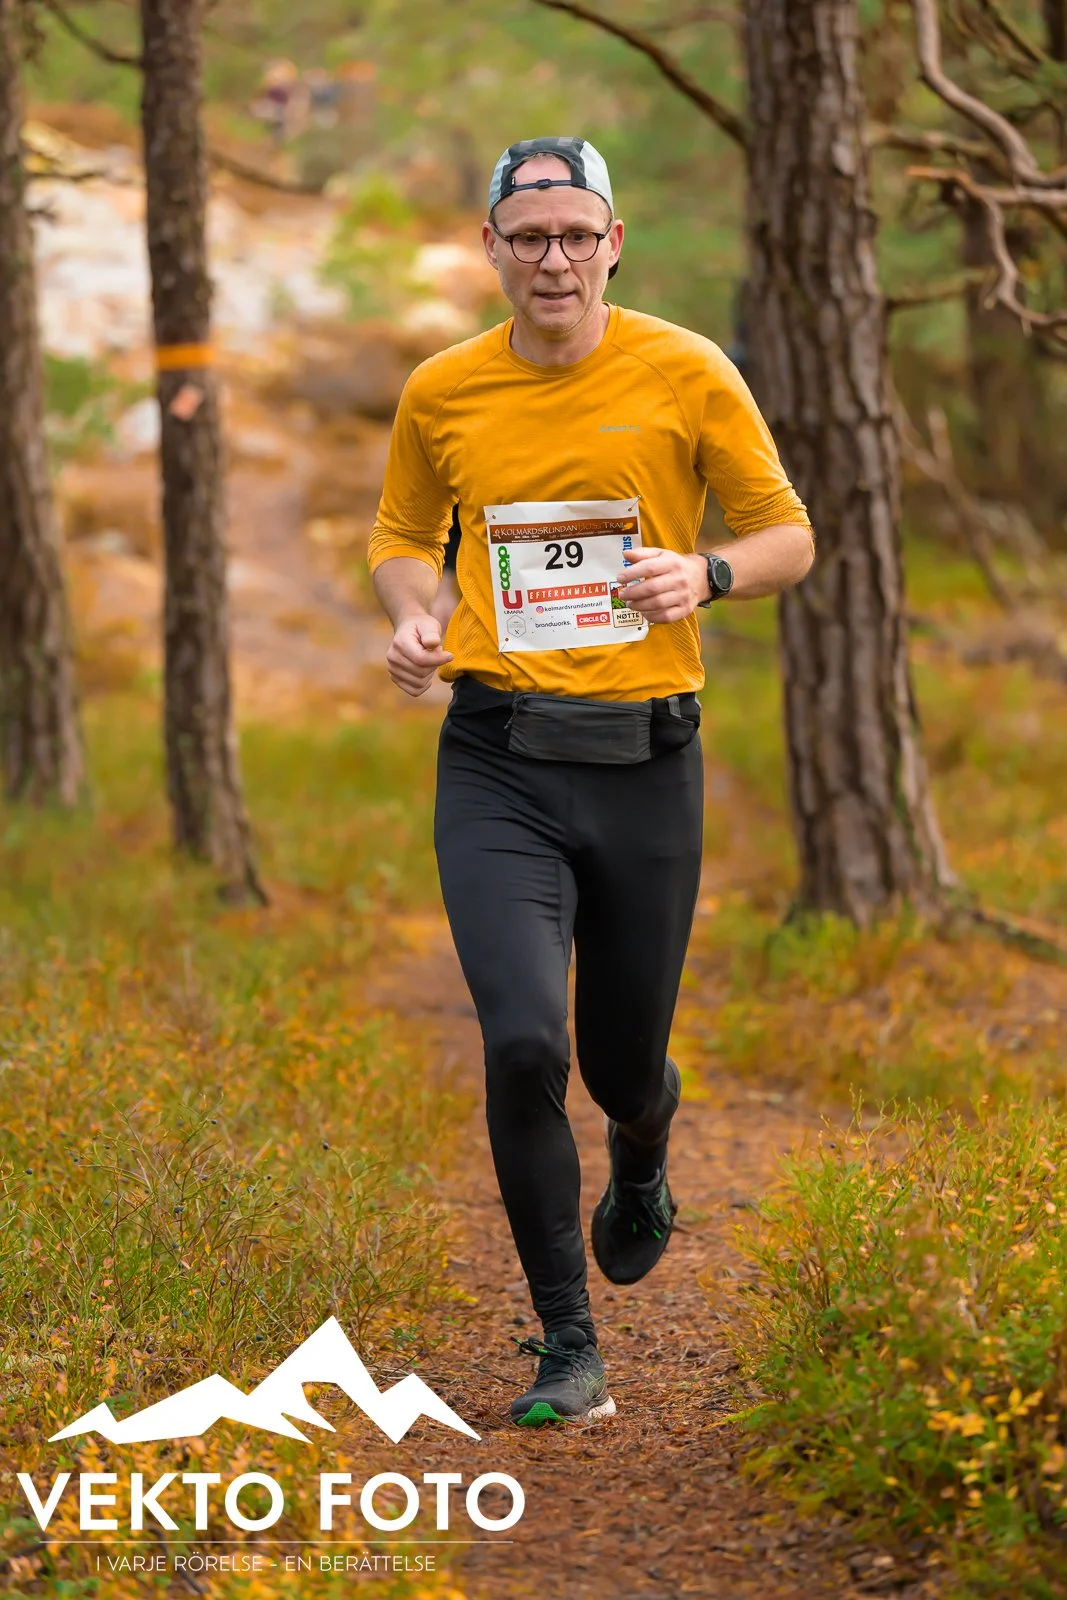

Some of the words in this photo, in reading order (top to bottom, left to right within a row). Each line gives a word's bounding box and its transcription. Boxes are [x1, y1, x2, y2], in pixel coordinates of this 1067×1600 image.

[545, 541, 584, 570] 29
[498, 545, 510, 590] coop
[529, 584, 606, 600] EFTERANMÄLAN
[544, 601, 603, 612] kolmardsrundantrail
[579, 616, 599, 624] CIRCLE
